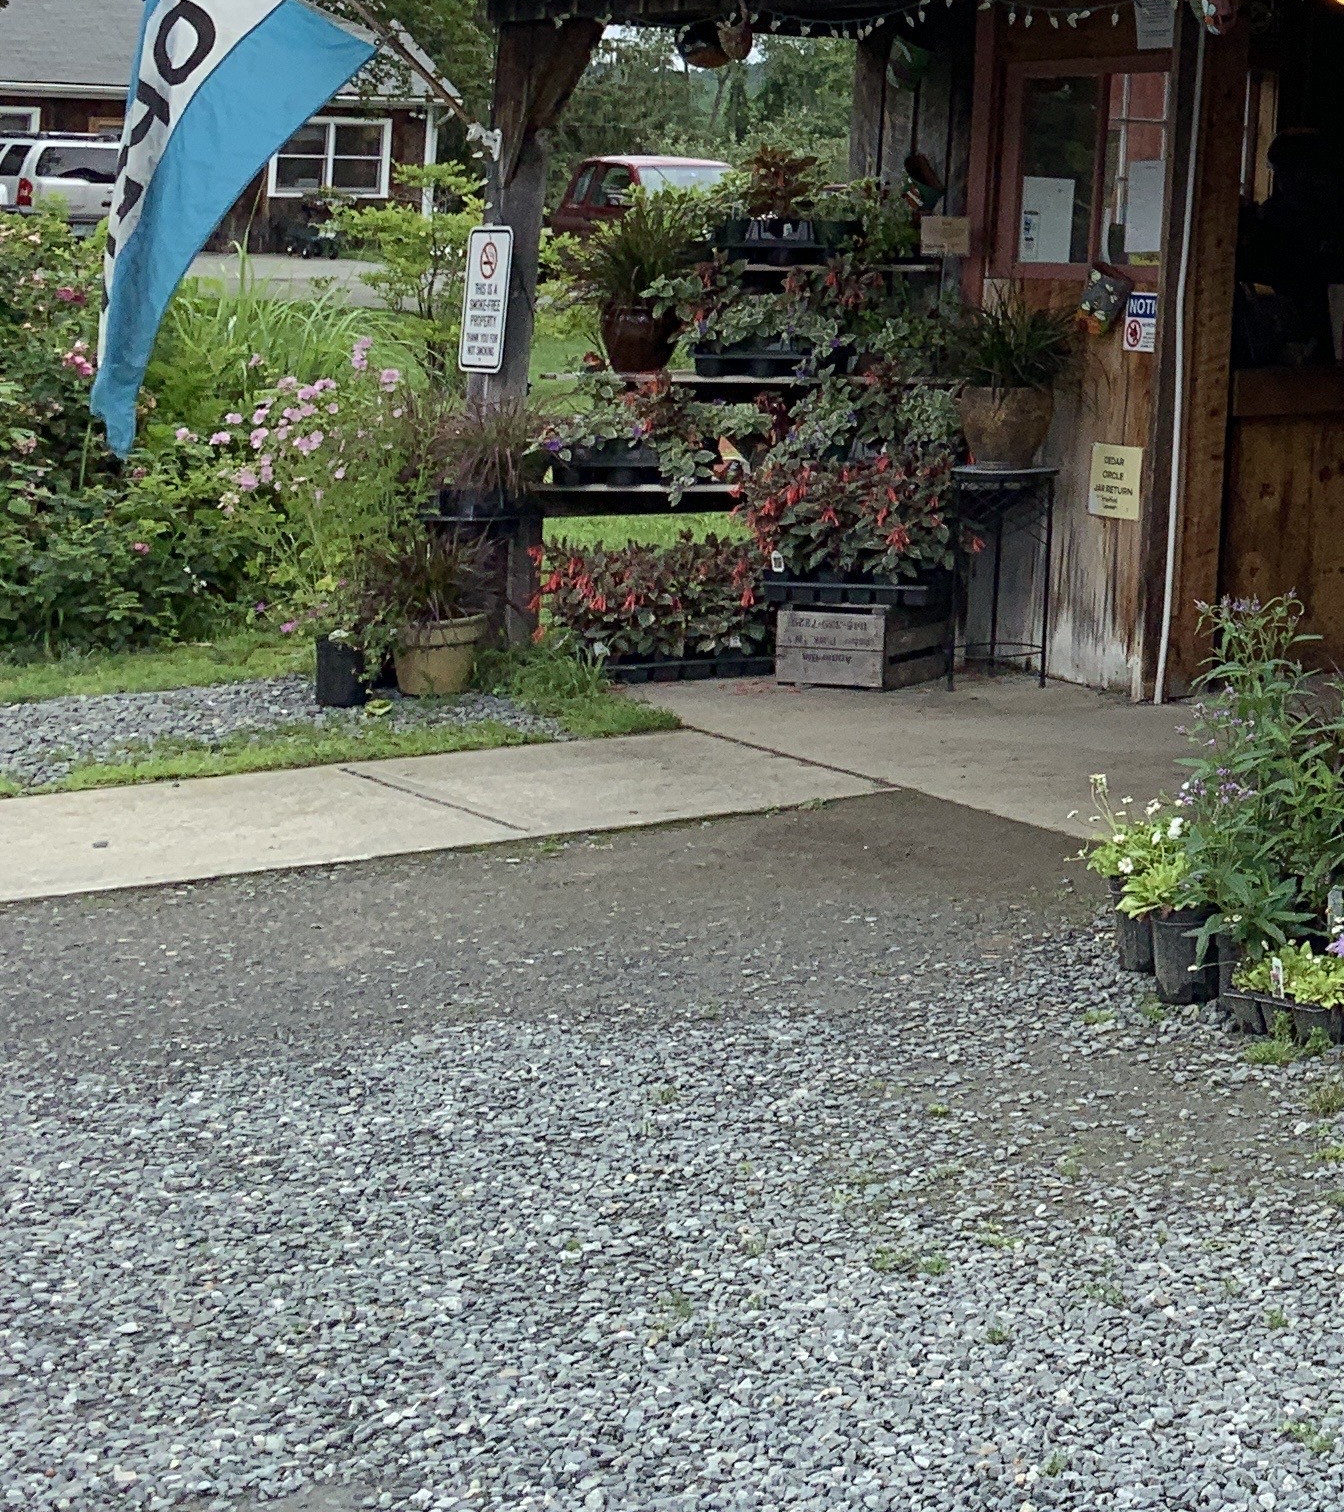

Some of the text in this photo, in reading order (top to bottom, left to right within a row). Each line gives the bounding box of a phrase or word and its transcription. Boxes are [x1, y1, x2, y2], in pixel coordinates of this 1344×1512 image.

[475, 282, 486, 296] THIS
[469, 298, 501, 312] SMOKE-FREE
[1130, 298, 1156, 314] NOTI
[470, 315, 497, 327] PROPERTY
[1104, 456, 1125, 466] CEDAR
[1102, 470, 1124, 481] CIRCLE
[1105, 484, 1133, 496] RETURN
